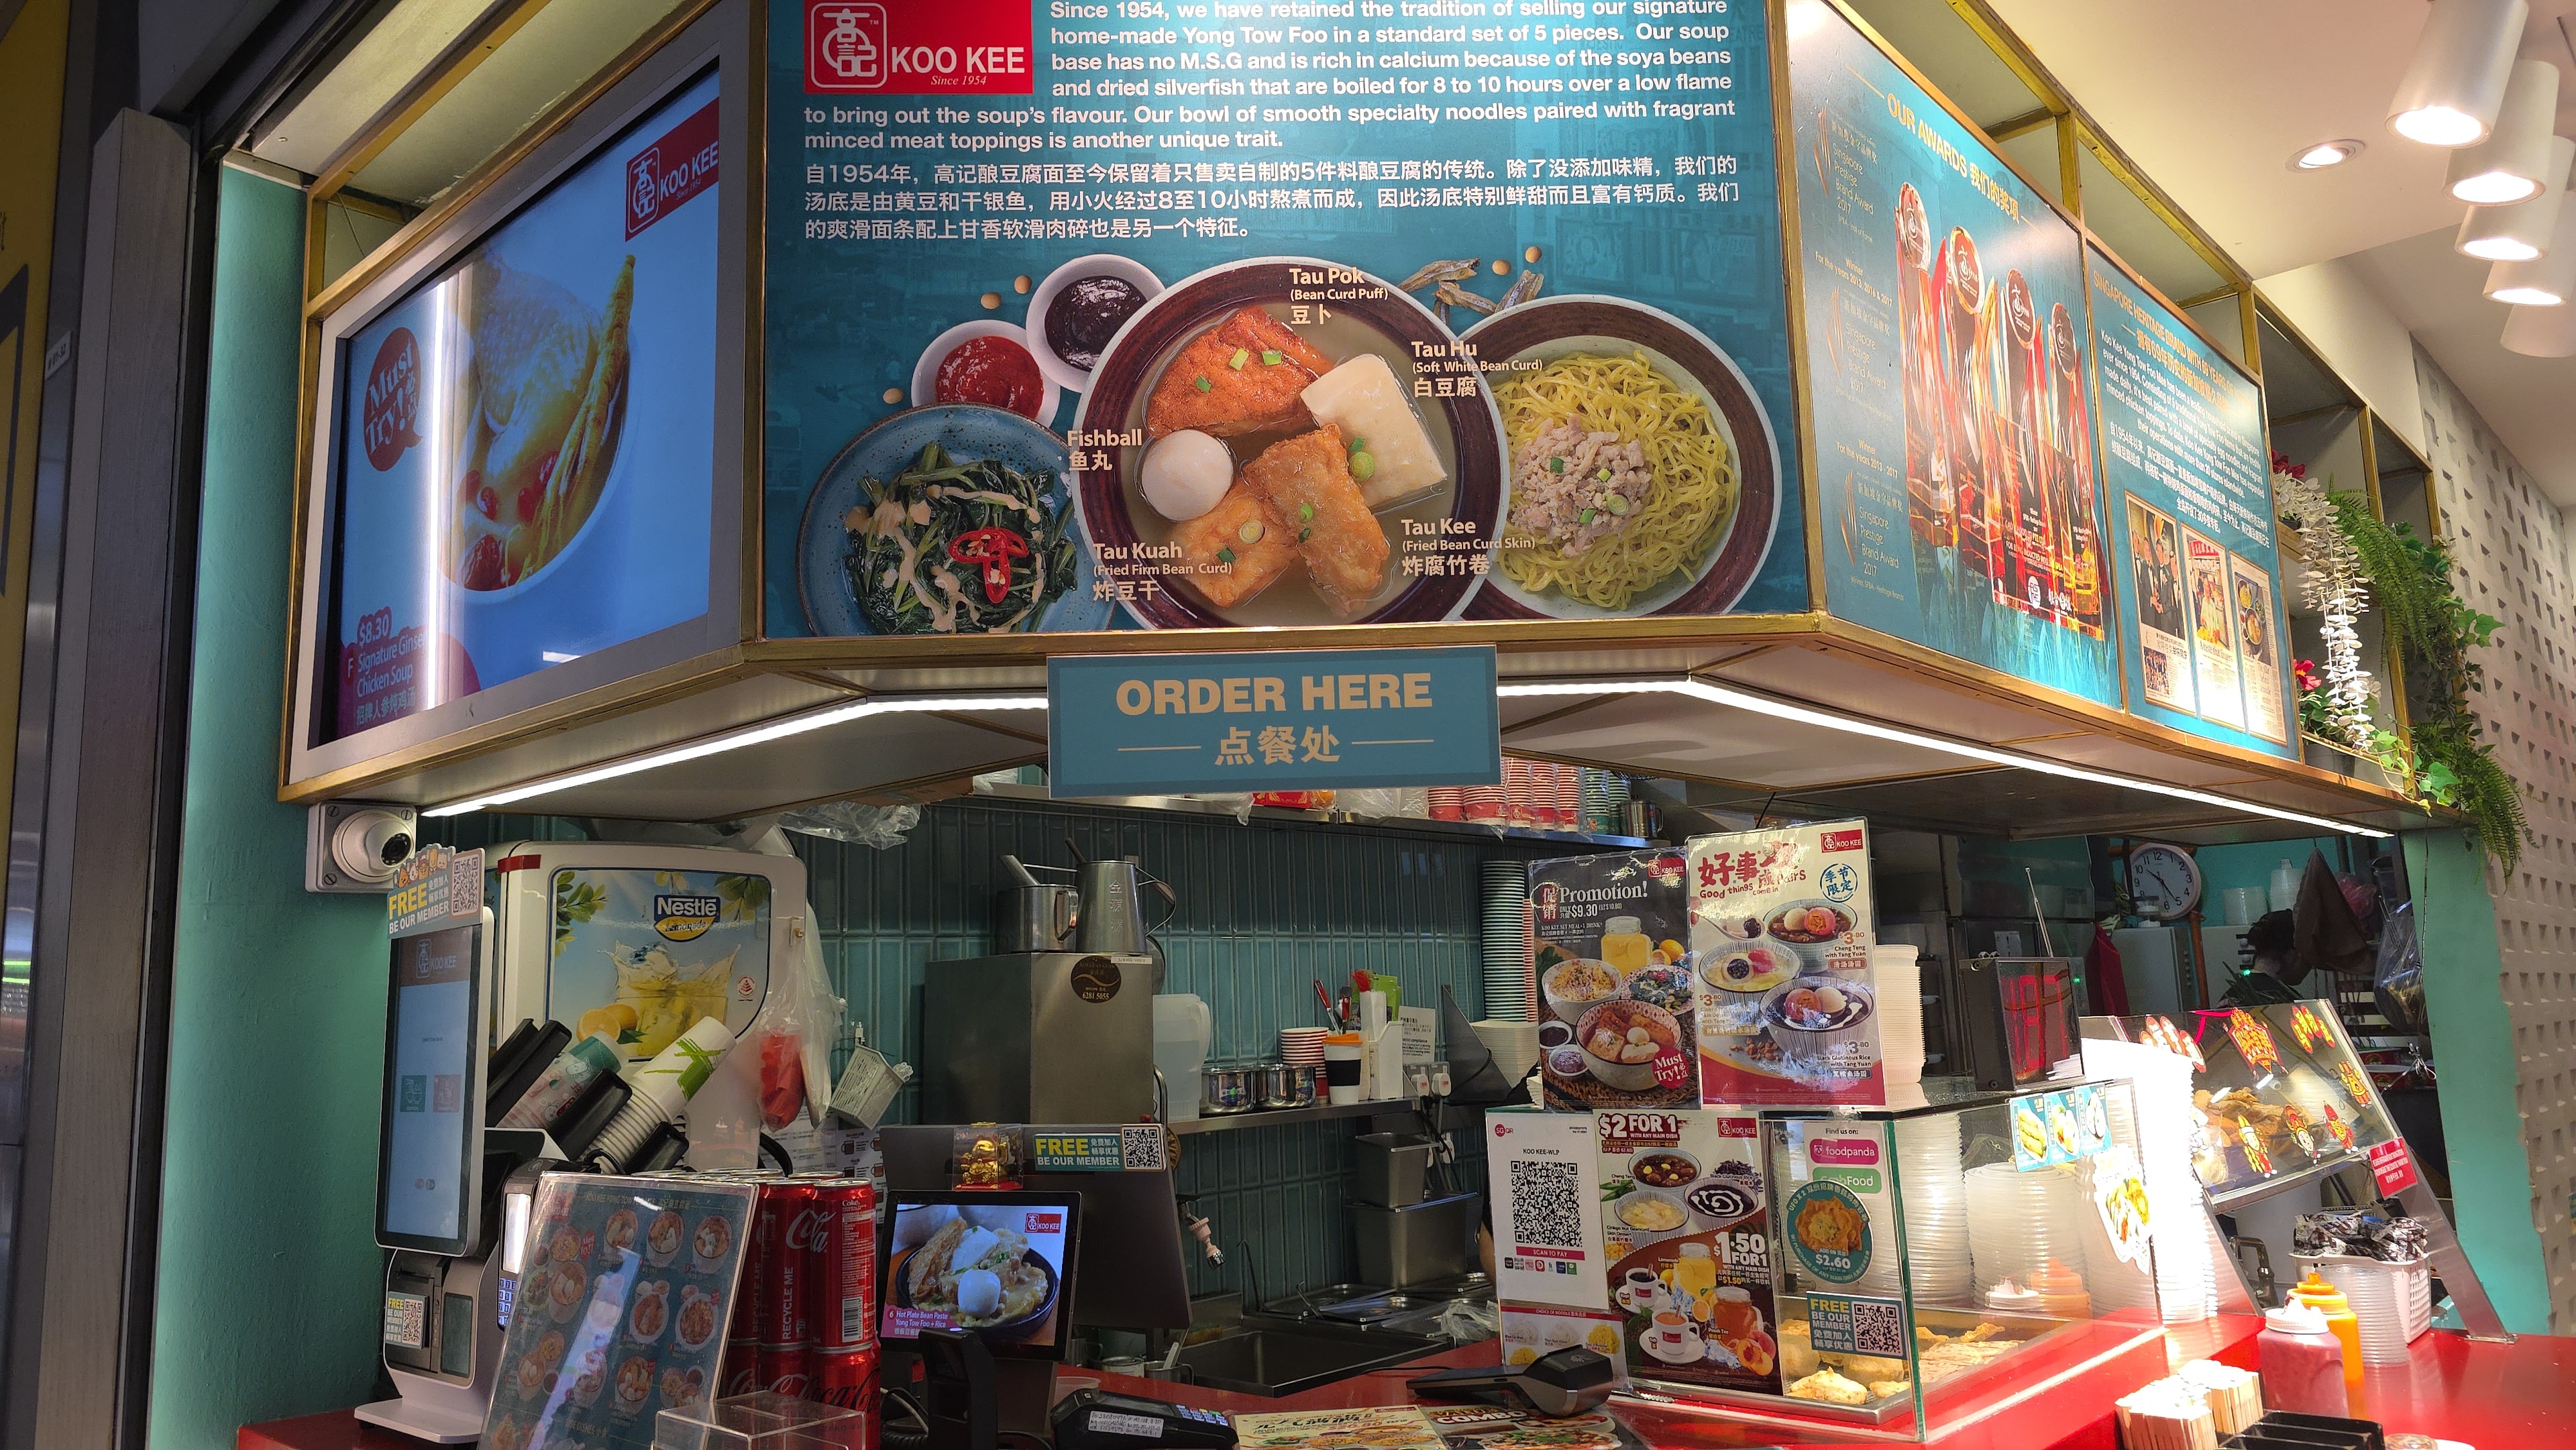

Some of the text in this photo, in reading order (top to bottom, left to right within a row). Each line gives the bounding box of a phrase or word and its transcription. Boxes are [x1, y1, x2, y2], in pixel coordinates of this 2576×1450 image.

[1050, 0, 1727, 21] Since 1954, we have retained the tradition of selling our signature
[892, 46, 1025, 74] KOO KEE
[931, 75, 987, 86] Since 1954
[804, 100, 1735, 127] to bring out the soup's flavour. Our bowl of smooth specialty noodles paired with fragrant
[805, 129, 1283, 153] minced meat toppings is another unique trait.
[1887, 93, 1968, 178] OUR AWARDS
[660, 140, 718, 201] KOO KEE
[1289, 267, 1364, 285] Tau Pok
[1290, 287, 1389, 302] (Bean Curd Puff)
[2093, 269, 2133, 317] SINGAPORE
[1291, 304, 1333, 325] 豆卜
[1411, 340, 1478, 358] Tau Hu
[1412, 357, 1543, 375] (Soft White Bean Curd)
[1414, 377, 1478, 398] 白豆腐
[1067, 429, 1142, 447] Fishball
[1068, 451, 1113, 472] 鱼丸
[1401, 518, 1477, 536] Tau Kee
[1859, 506, 1889, 530] Singapore
[1093, 542, 1182, 560] Tau Kuah
[1402, 537, 1536, 552] (Fried Bean Curd Skin)
[1402, 553, 1491, 577] 炸腐竹卷
[1862, 543, 1899, 569] Brand Award
[1093, 561, 1232, 577] (Fried Firm Bean Curd)
[1863, 561, 1877, 577] 2017
[1093, 580, 1159, 602] 炸豆干
[360, 614, 389, 649] $8.30
[358, 645, 397, 675] Signature
[357, 663, 413, 698] Chicken Soup
[1116, 672, 1433, 716] ORDER HERE
[1215, 725, 1340, 766] 点餐处
[1850, 838, 1862, 846] KEE
[2153, 852, 2162, 860] 12
[2135, 865, 2143, 874] 10
[2178, 862, 2186, 871] 2
[2134, 878, 2140, 887] 9
[2186, 874, 2192, 883] 3
[1560, 881, 1648, 903] Promotion!
[1700, 889, 1725, 899] Good
[1727, 883, 1754, 895] things
[1753, 887, 1770, 895] come
[2184, 887, 2190, 896] 4
[389, 883, 427, 920] FREE
[2163, 901, 2170, 909] 6
[2176, 897, 2182, 905] 5
[389, 900, 449, 934] BE OUR MEMBER
[1571, 903, 1598, 918] $9.30
[1655, 1053, 1682, 1069] Must
[1654, 1066, 1680, 1081] Try!
[1599, 1114, 1676, 1137] $2 FOR 1
[1035, 1139, 1089, 1156] FREE
[1091, 1138, 1118, 1146] 免费加入
[1825, 1146, 1875, 1158] foodpanda
[1038, 1157, 1120, 1166] BE OUR MEMBER
[1713, 1231, 1766, 1264] $1.50
[1815, 1254, 1850, 1269] $2.60
[782, 1266, 794, 1340] RECYCLE ME
[1810, 1298, 1849, 1314] FREE
[896, 1319, 908, 1327] Yong
[1811, 1310, 1849, 1323] BE OUR
[1812, 1320, 1851, 1331] MEMBER
[1813, 1329, 1853, 1341] 免费加入
[1814, 1339, 1854, 1351] 畅享优惠
[1436, 1408, 1529, 1425] COMBO
